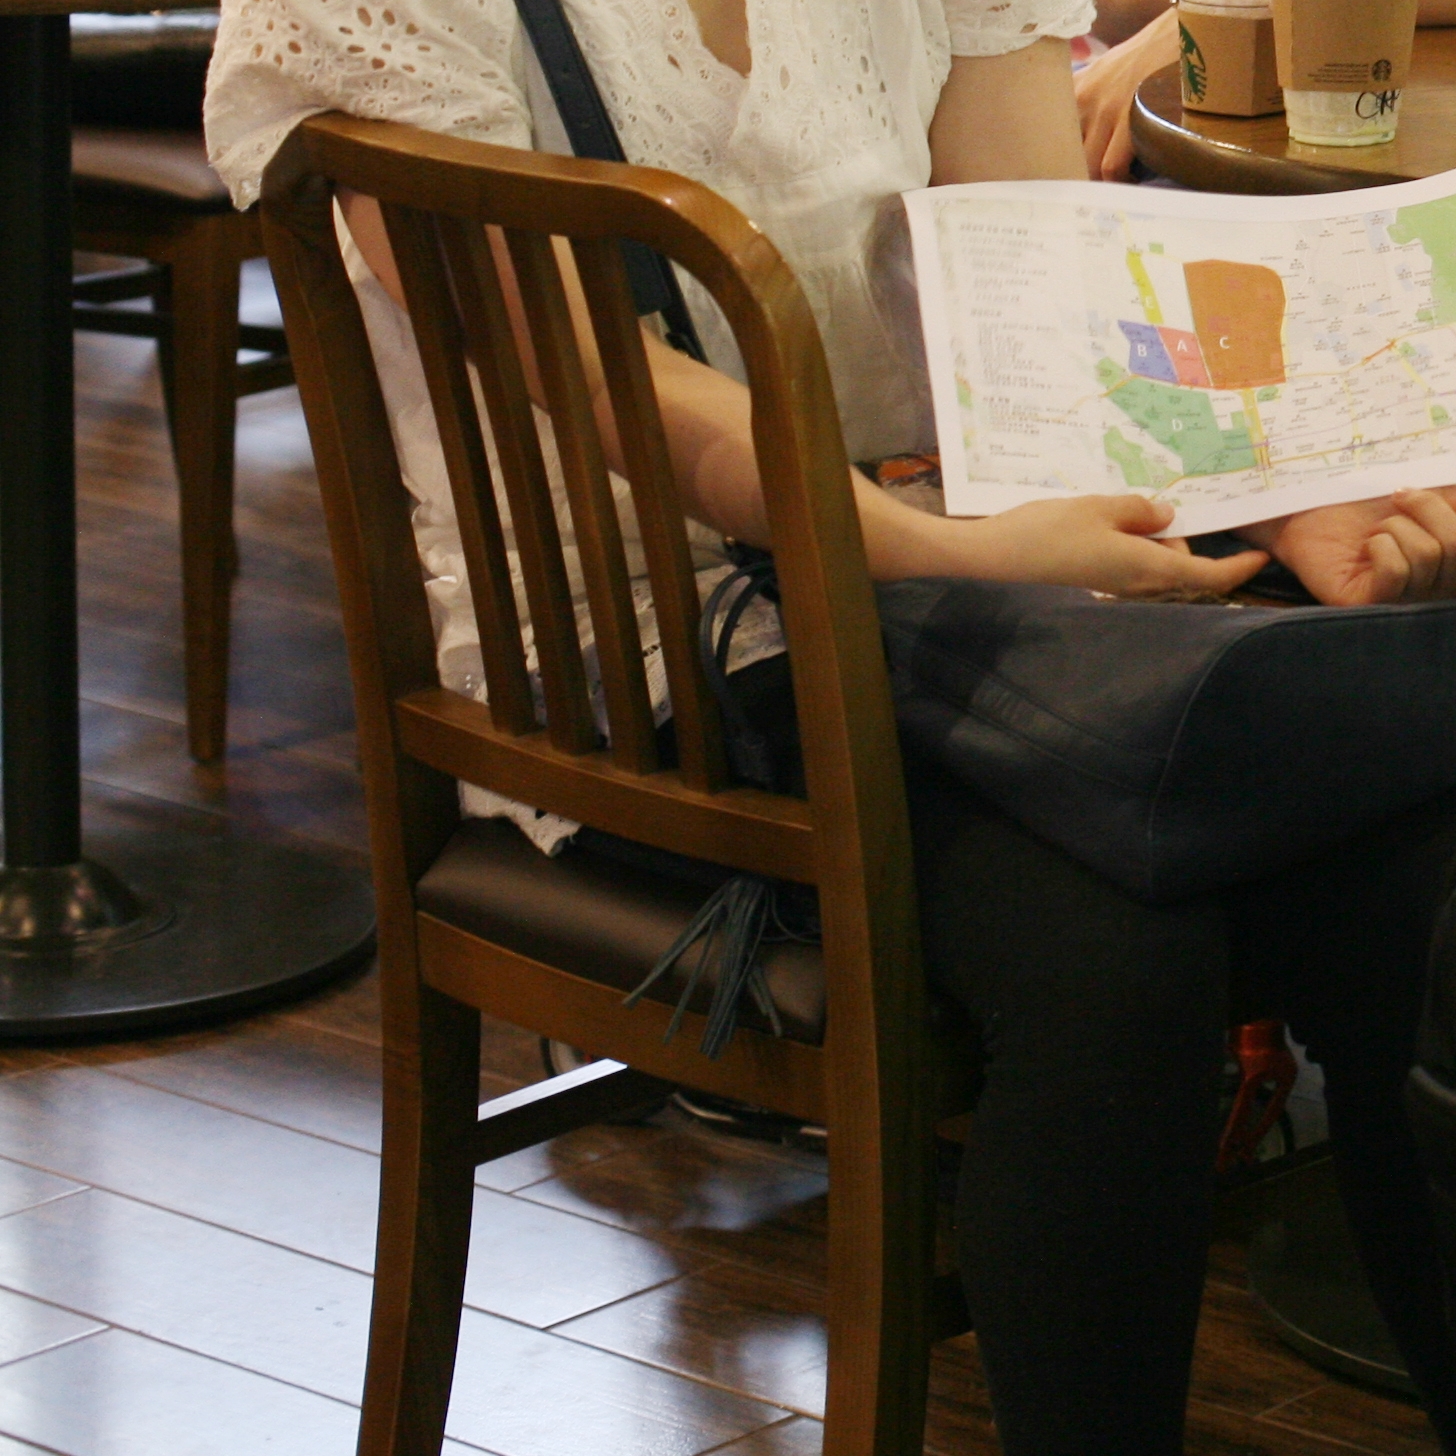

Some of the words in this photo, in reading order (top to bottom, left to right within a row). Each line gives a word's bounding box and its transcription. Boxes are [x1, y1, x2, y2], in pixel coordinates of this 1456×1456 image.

[1177, 340, 1188, 352] A
[1219, 336, 1230, 349] C
[1137, 344, 1147, 357] B
[1172, 419, 1182, 430] D
